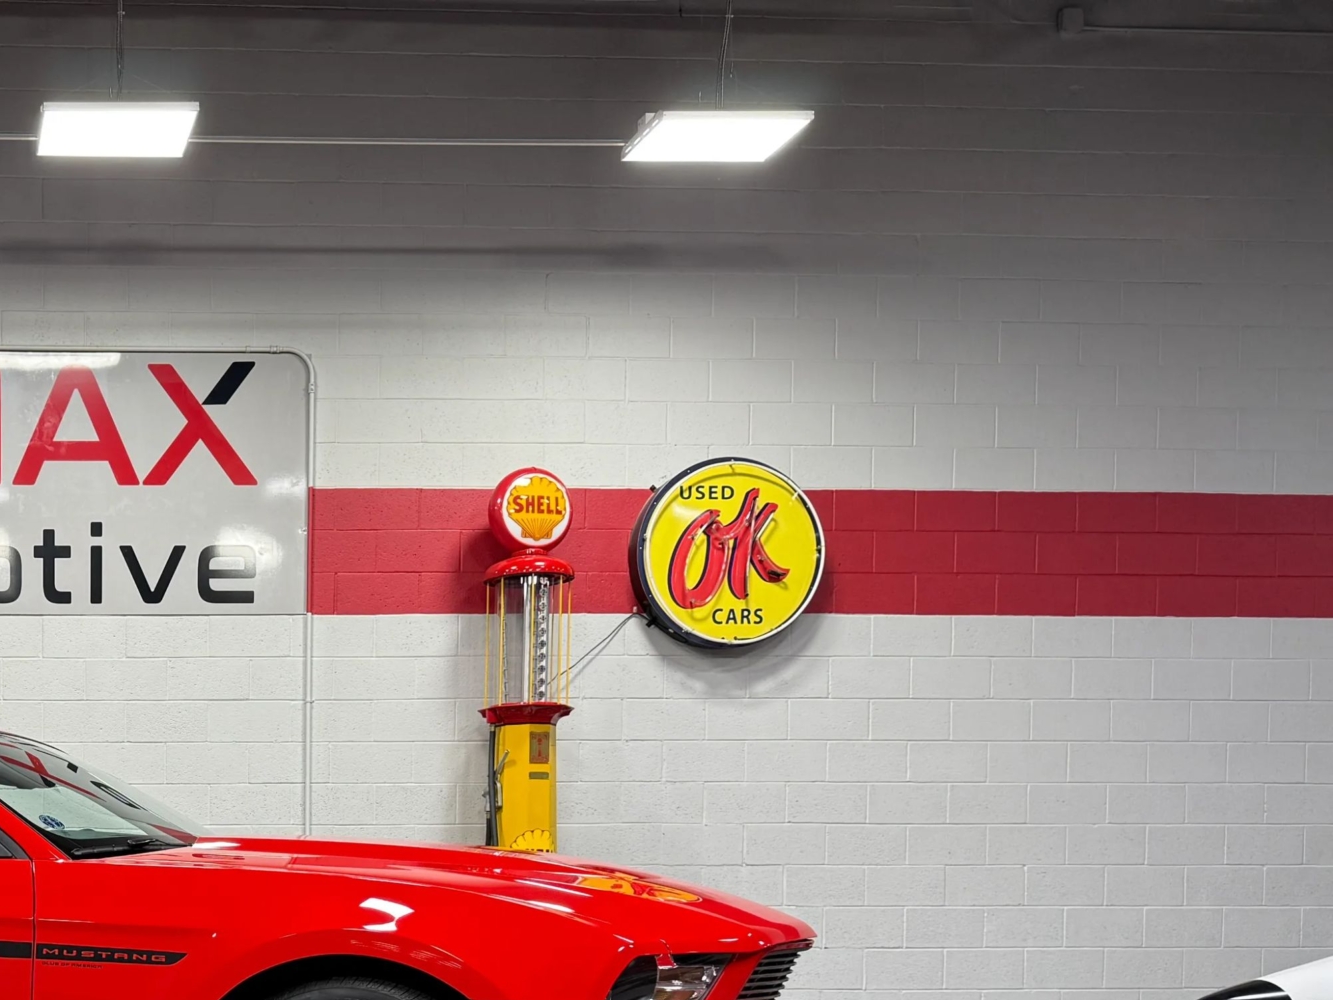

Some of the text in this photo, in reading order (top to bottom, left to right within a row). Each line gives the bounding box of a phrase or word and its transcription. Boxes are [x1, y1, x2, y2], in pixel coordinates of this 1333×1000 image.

[679, 484, 735, 502] USED
[512, 494, 566, 516] SHELL
[668, 488, 791, 609] OK
[711, 608, 764, 626] CARS
[42, 948, 166, 962] MUSTANG
